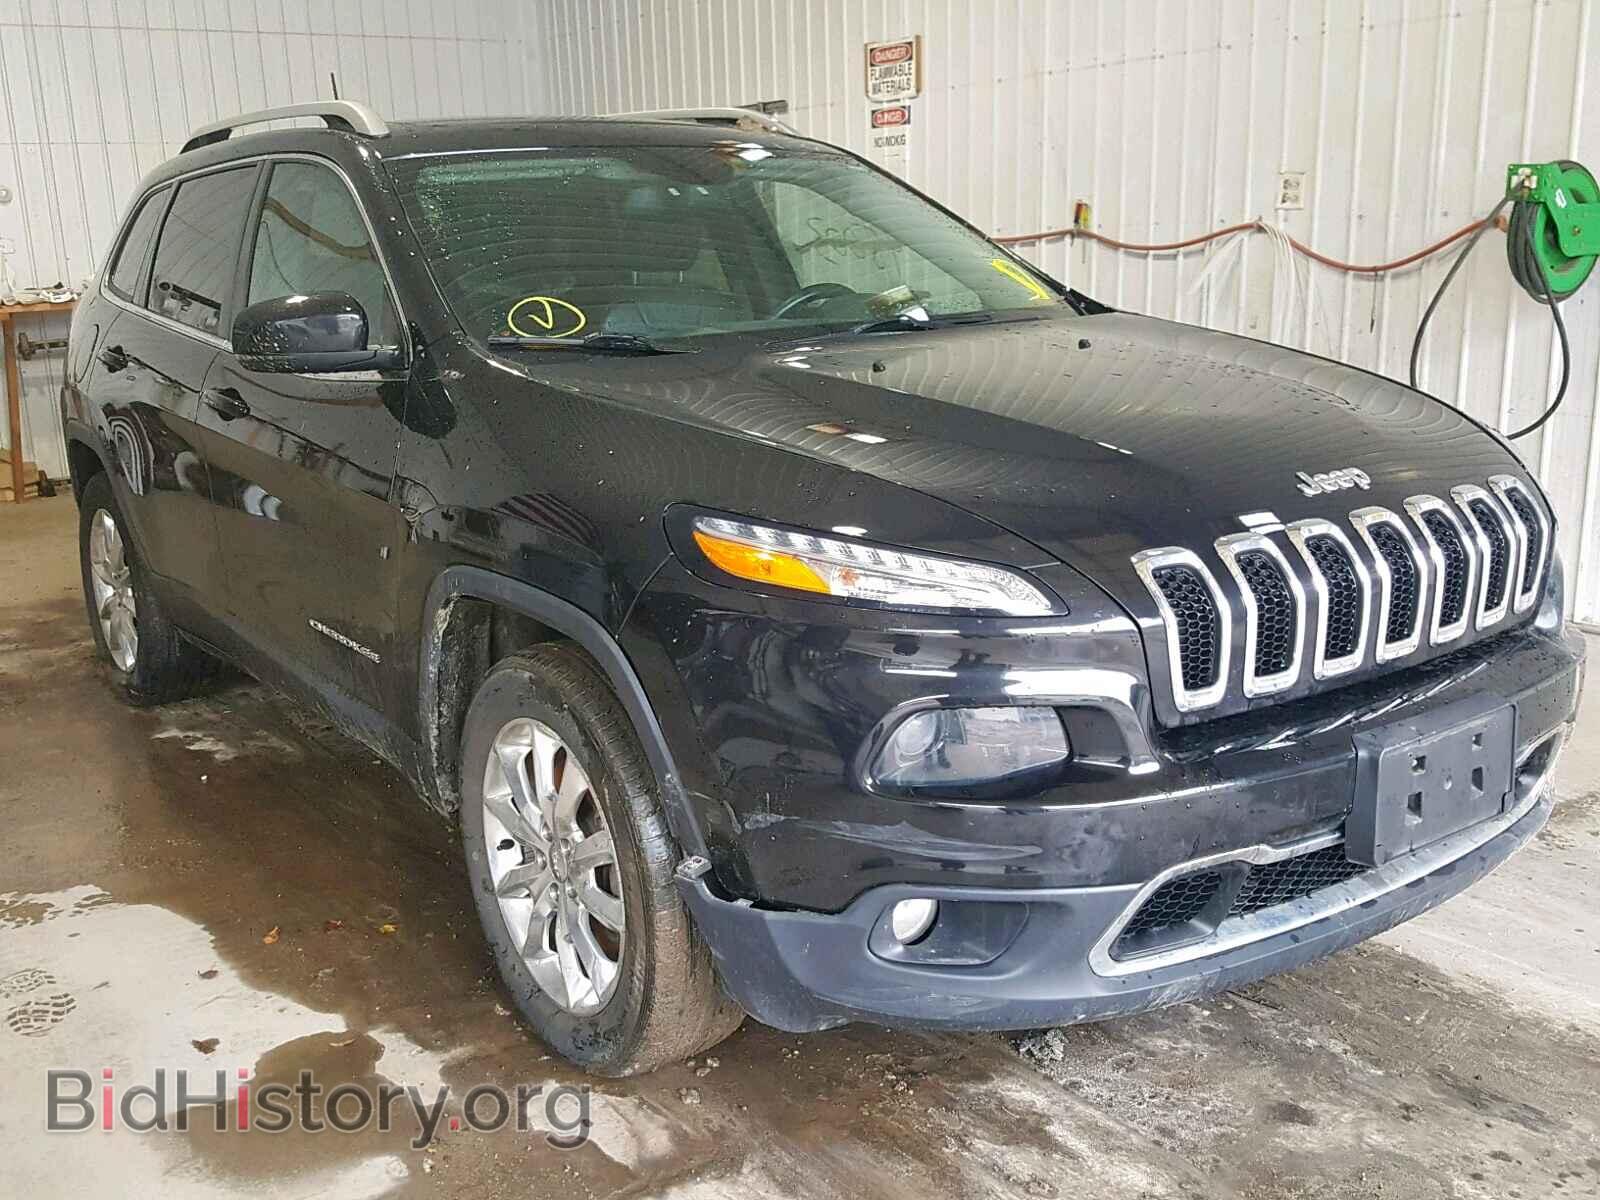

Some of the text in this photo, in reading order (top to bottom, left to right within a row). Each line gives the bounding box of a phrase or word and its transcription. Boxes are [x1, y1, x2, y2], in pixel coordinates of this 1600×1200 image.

[870, 63, 912, 80] FLAMMABLE
[871, 77, 911, 95] MATERIALS
[1296, 467, 1371, 497] Jeep
